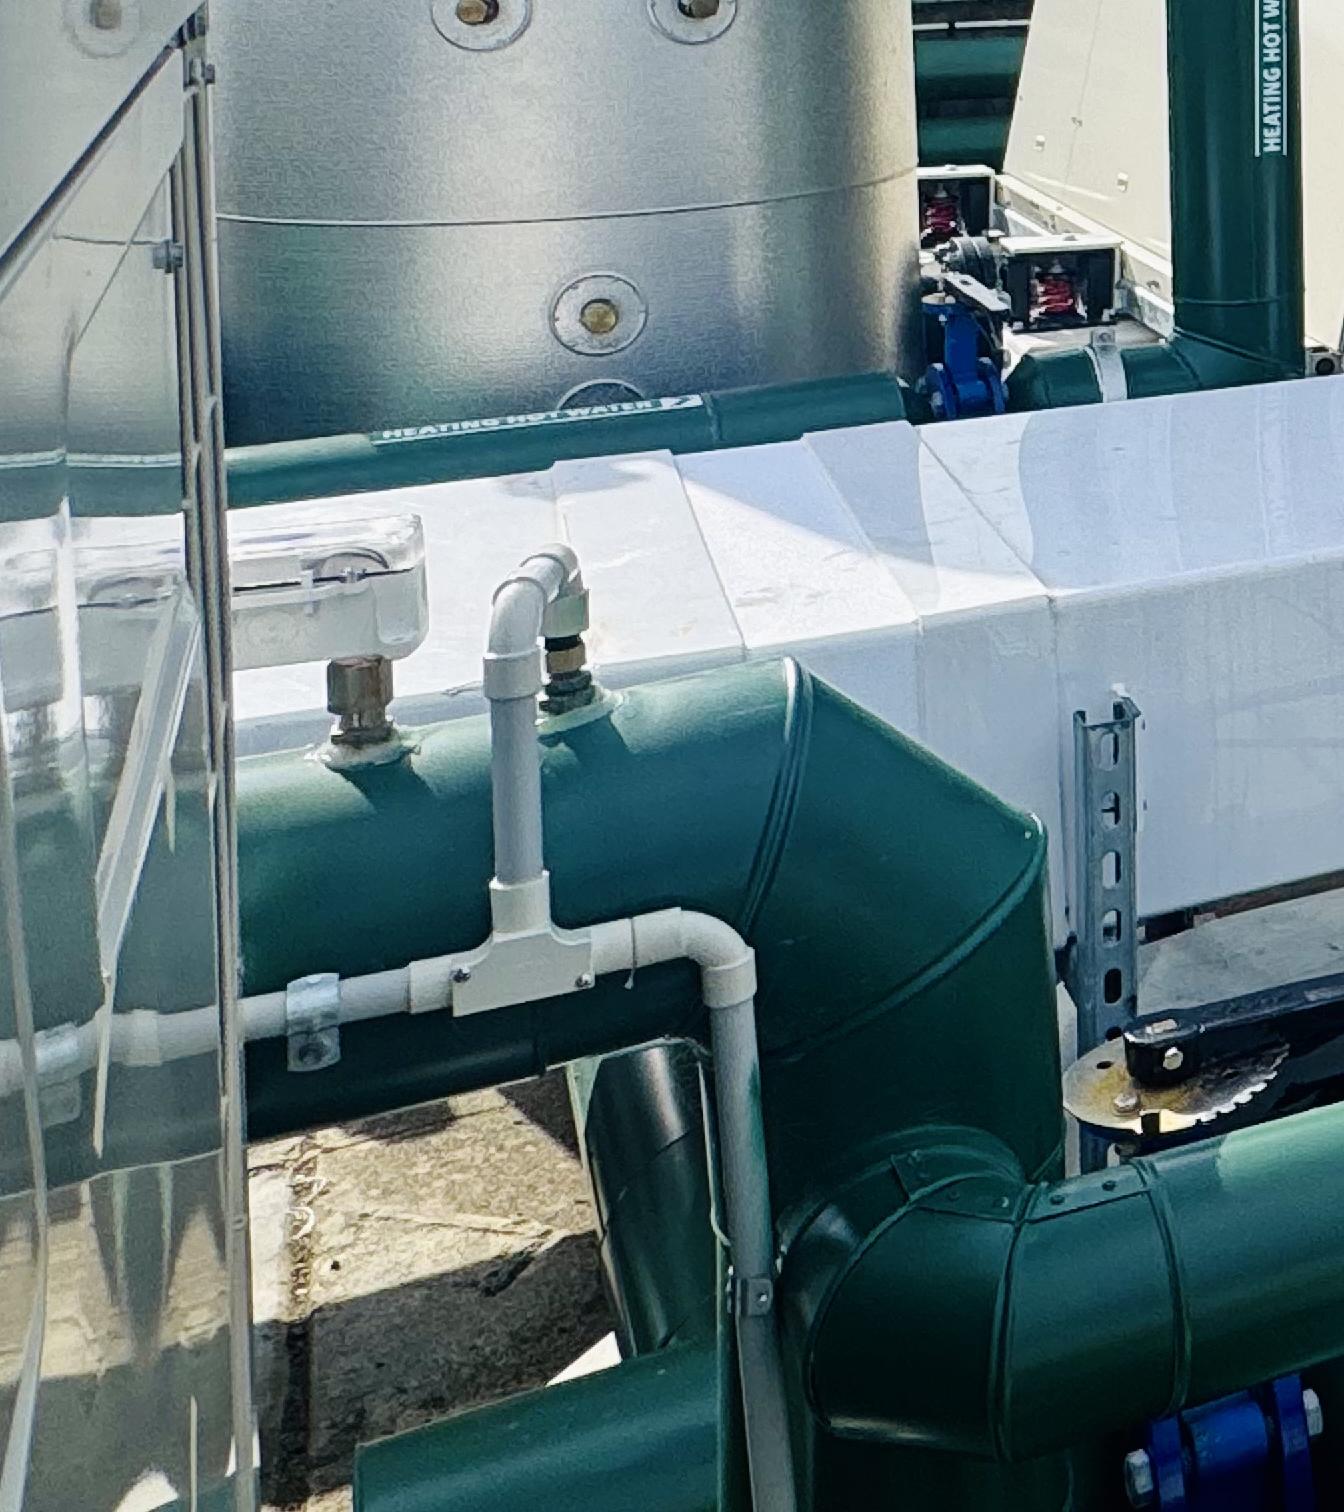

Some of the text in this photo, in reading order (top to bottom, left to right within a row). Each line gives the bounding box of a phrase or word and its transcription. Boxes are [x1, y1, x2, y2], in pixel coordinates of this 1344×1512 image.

[1262, 21, 1282, 63] HOT
[1262, 66, 1282, 153] HEATING
[382, 418, 500, 439] HEATING
